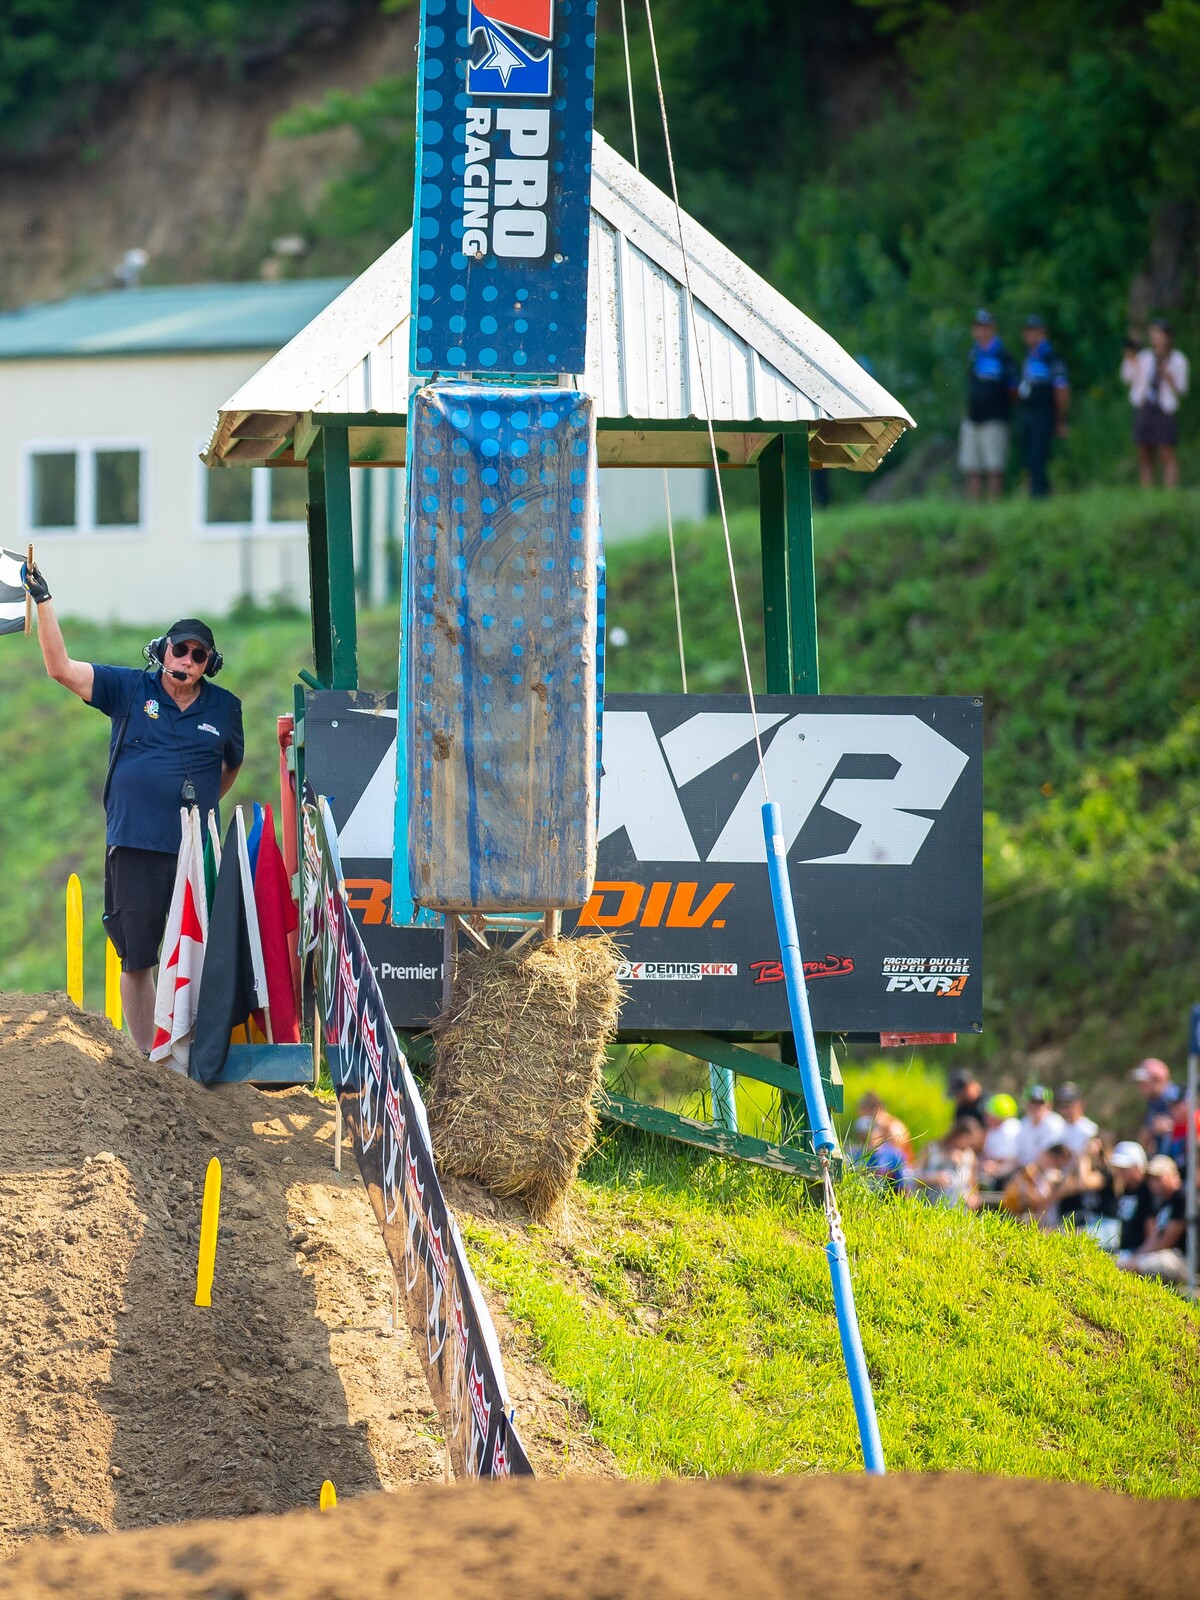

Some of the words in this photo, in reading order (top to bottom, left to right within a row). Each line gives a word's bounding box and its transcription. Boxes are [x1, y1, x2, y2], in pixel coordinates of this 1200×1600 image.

[462, 107, 492, 257] RACING
[492, 108, 550, 258] PRO
[577, 881, 736, 929] DIV.
[381, 962, 438, 980] Premier
[882, 957, 927, 965] FACTORY
[928, 957, 969, 965] OUTLET
[929, 965, 969, 973] STORE
[363, 1021, 381, 1077] RACER
[469, 1375, 487, 1432] RACER
